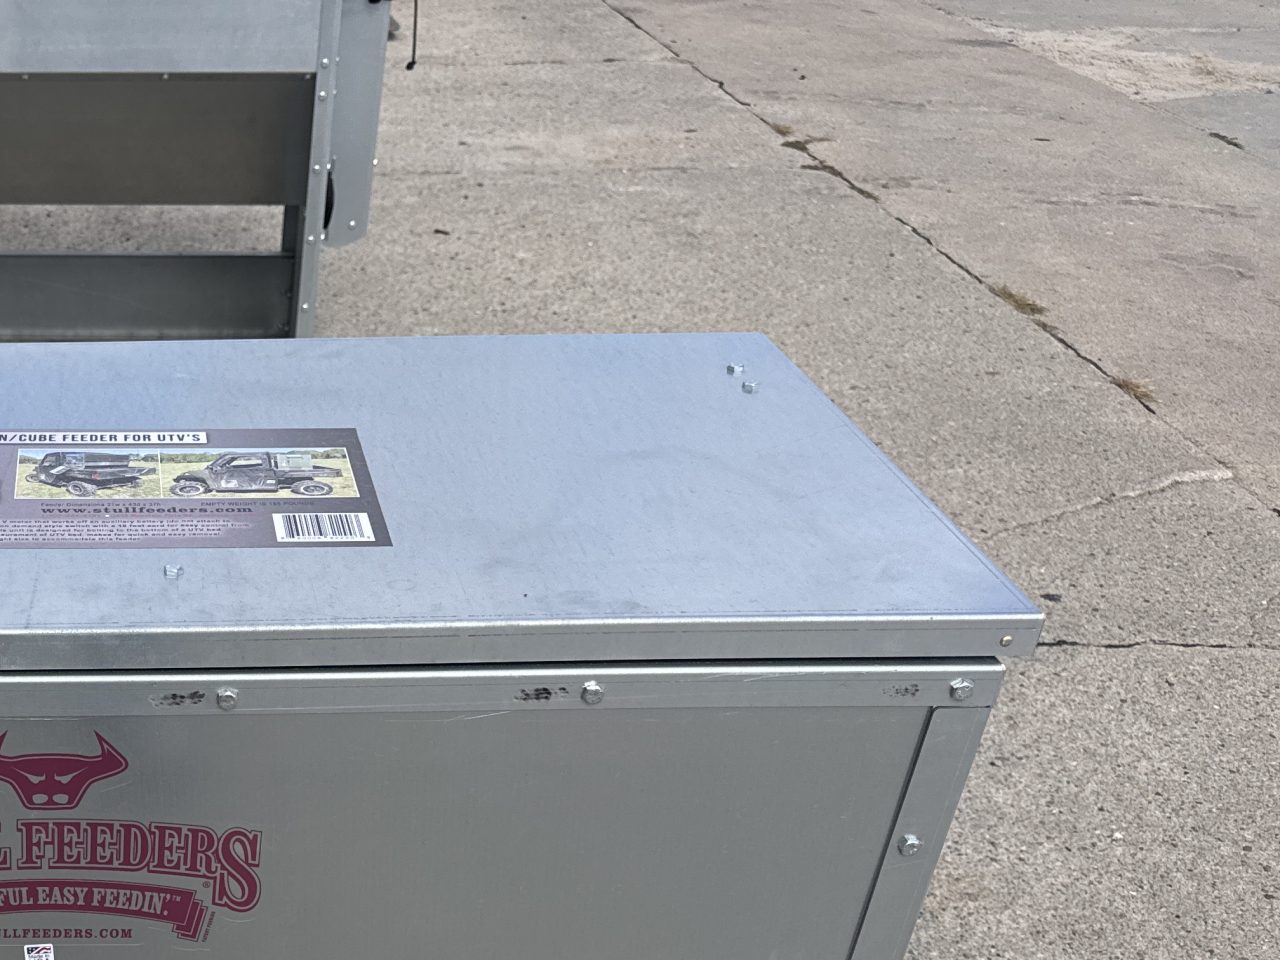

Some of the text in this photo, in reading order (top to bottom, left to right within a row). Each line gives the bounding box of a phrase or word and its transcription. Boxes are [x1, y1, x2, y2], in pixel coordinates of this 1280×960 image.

[62, 434, 118, 442] FEEDER
[124, 434, 152, 442] FOR
[158, 434, 202, 442] UTV'S
[17, 818, 262, 912] FEEDERS
[37, 886, 88, 905] EASY
